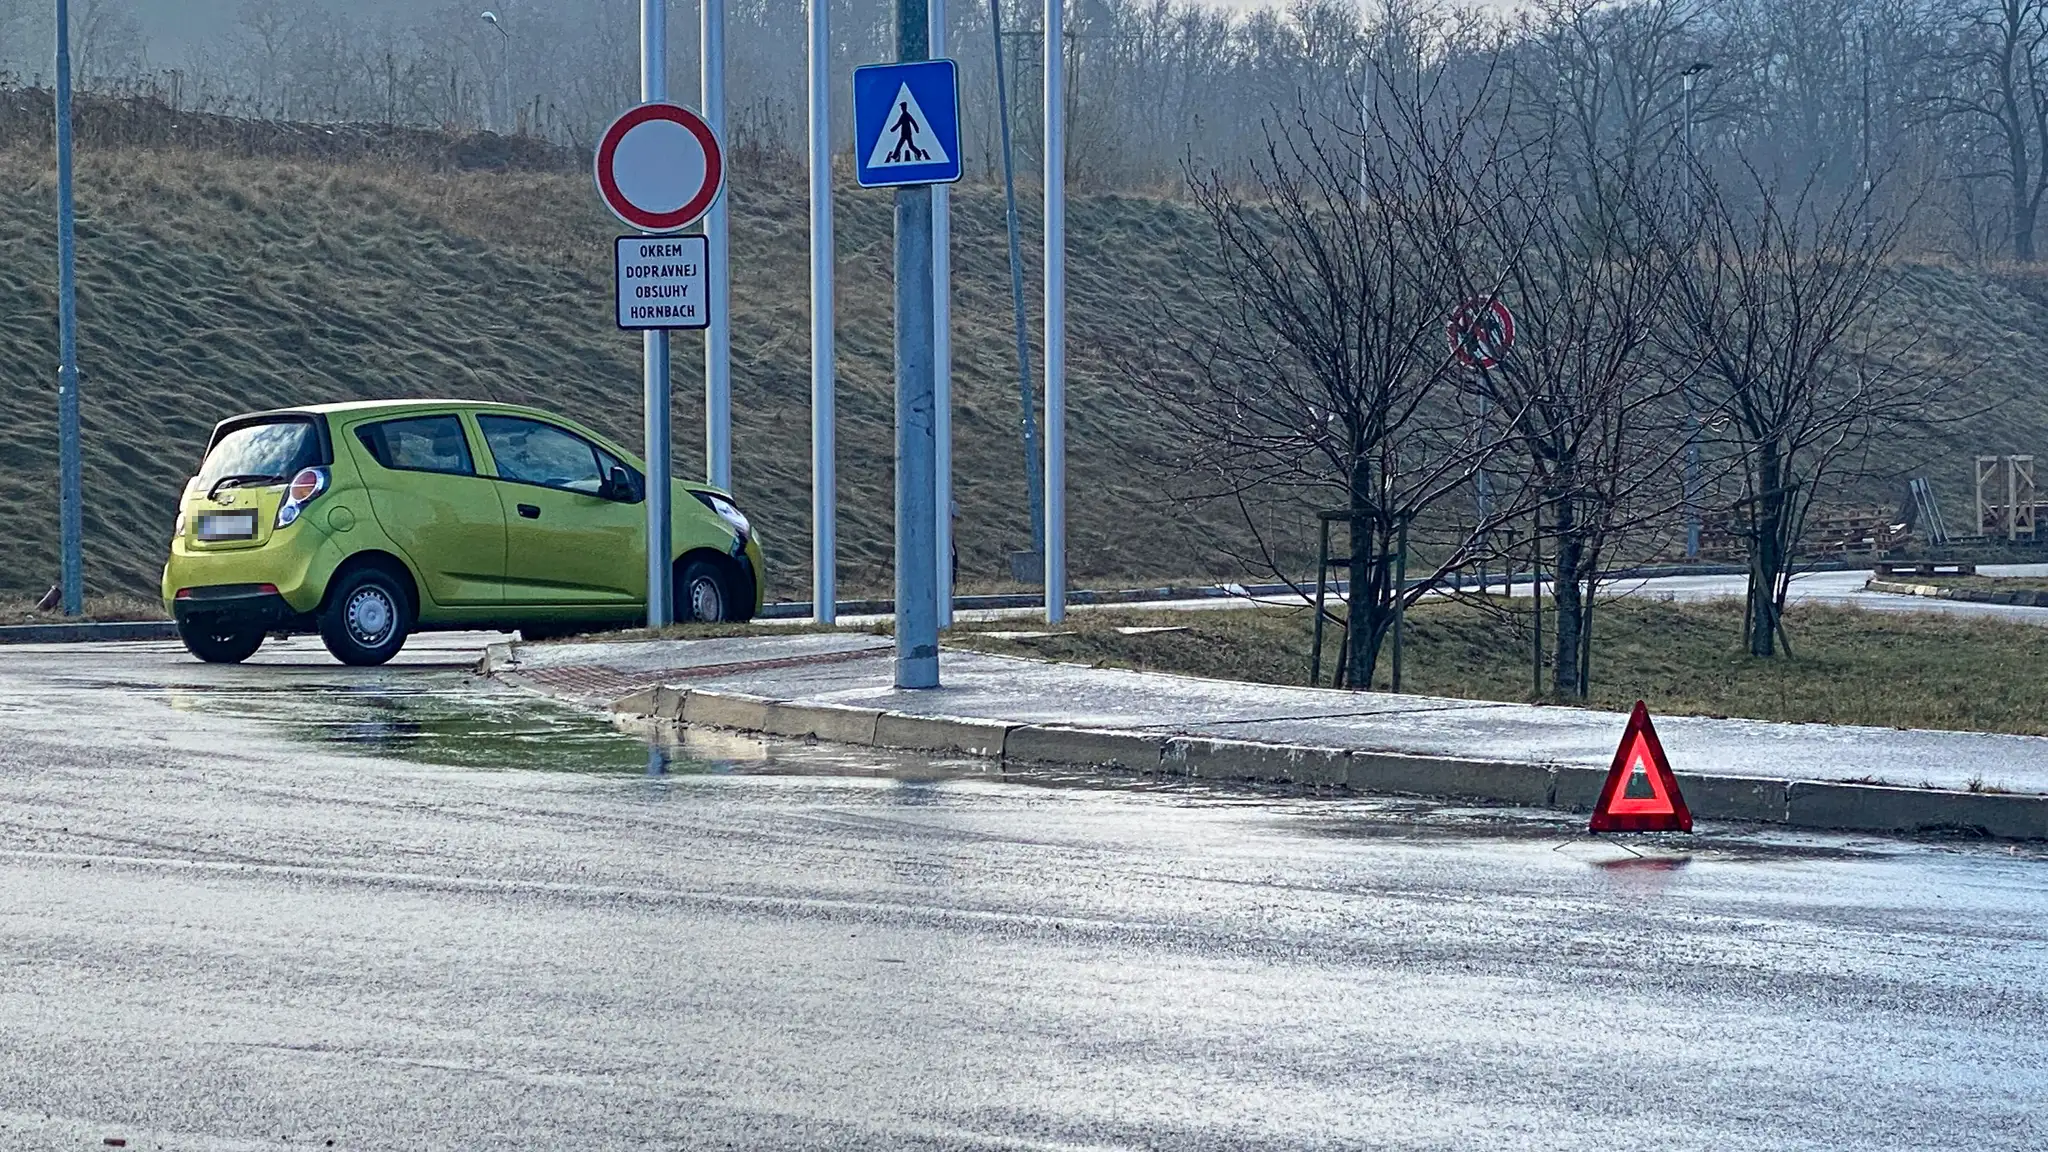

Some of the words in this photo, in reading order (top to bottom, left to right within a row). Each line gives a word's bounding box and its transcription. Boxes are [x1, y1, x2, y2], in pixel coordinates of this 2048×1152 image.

[640, 244, 682, 257] OKREM
[626, 264, 697, 278] DOPRAVNEJ
[635, 284, 688, 298] OBSLUHY
[630, 304, 695, 319] HORNBACH
